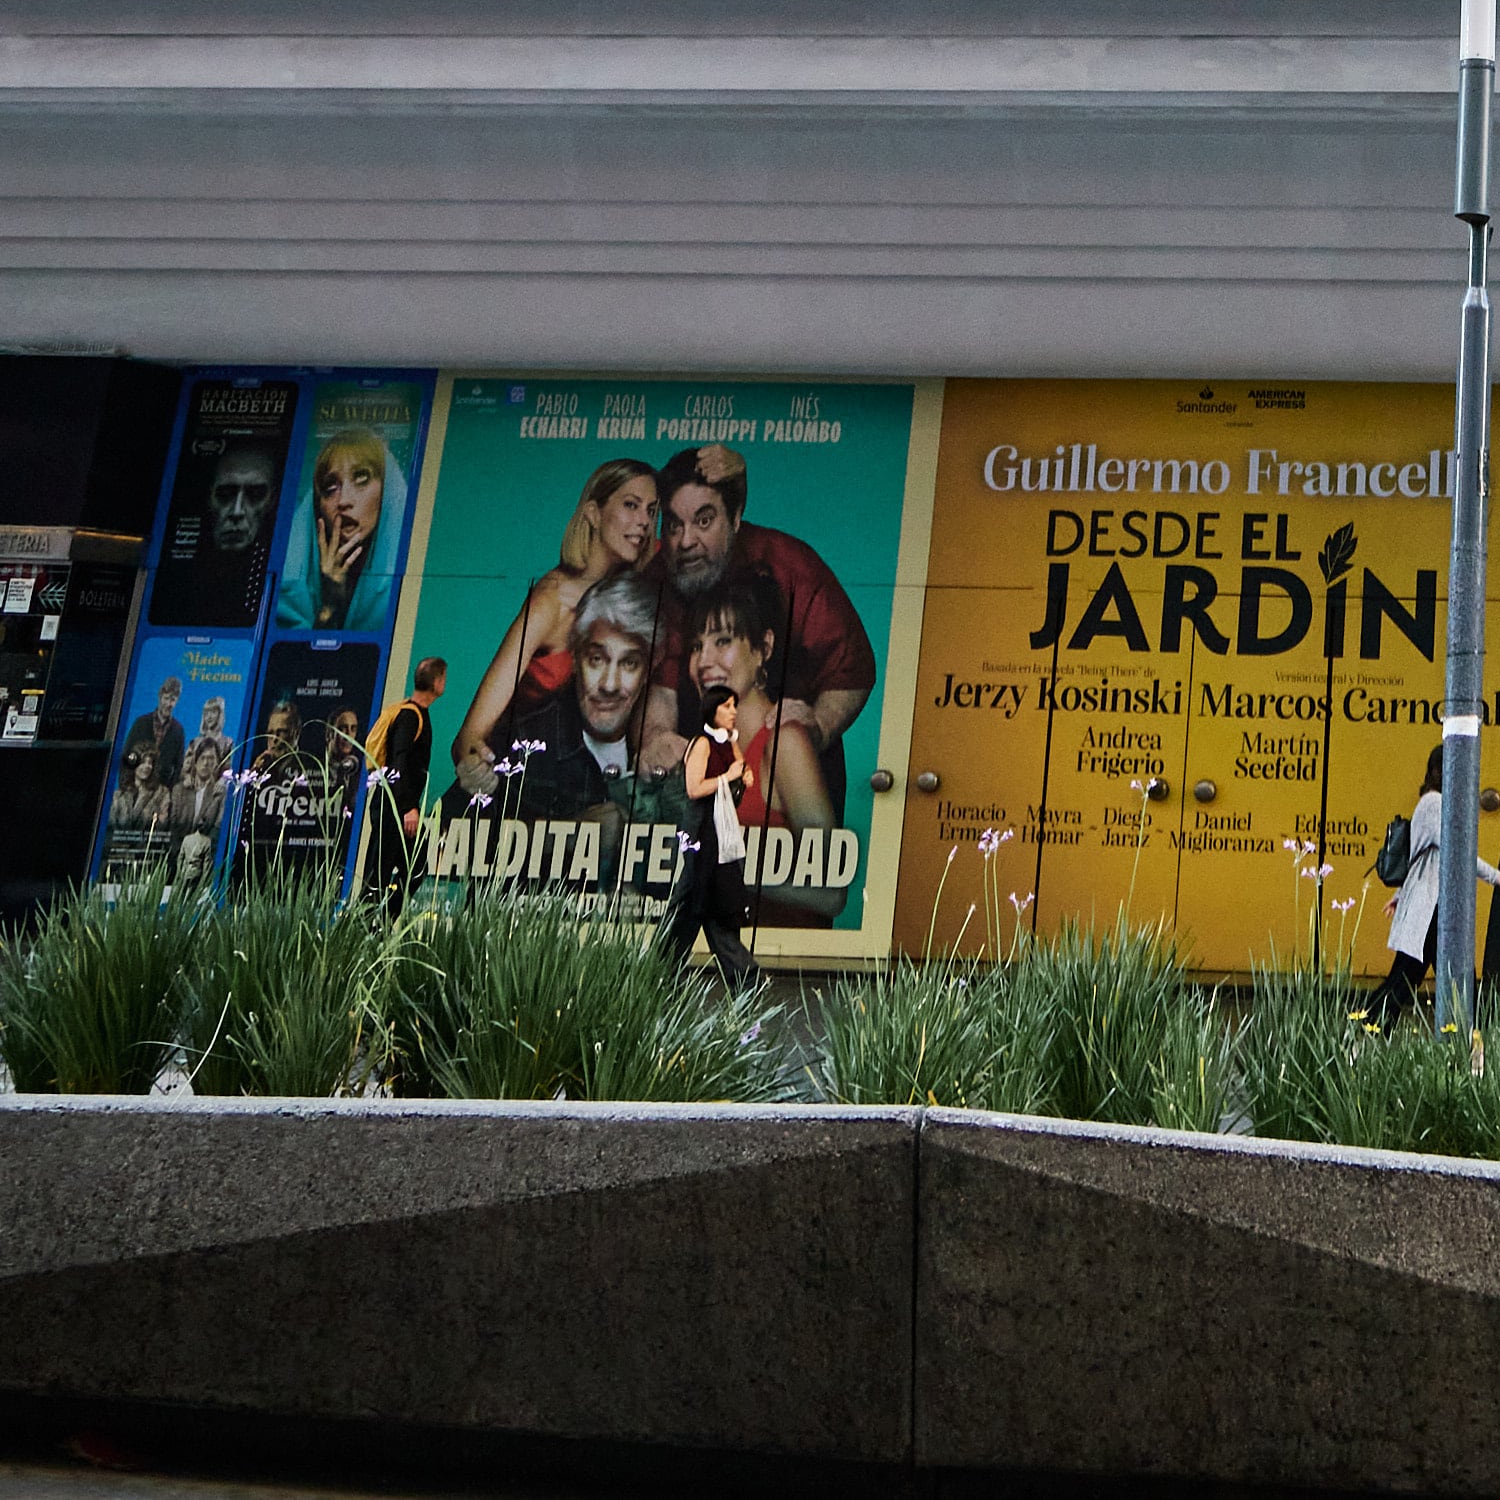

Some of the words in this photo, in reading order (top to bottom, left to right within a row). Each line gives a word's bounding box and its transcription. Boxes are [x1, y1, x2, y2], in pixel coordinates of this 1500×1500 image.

[199, 400, 286, 414] MACBETH
[535, 393, 579, 416] PABLO
[603, 393, 646, 417] PAOLA
[684, 394, 735, 419] CARLOS
[1176, 400, 1238, 414] Santander
[1247, 389, 1306, 400] AMERICAN
[1255, 400, 1306, 410] EXPRESS
[519, 415, 588, 440] ECHARRI
[597, 416, 646, 441] KRUM
[655, 417, 758, 442] PORTALUPPI
[763, 420, 842, 444] PALOMBO
[983, 442, 1231, 495] Guillermo
[1243, 448, 1457, 499] Francell
[1046, 509, 1224, 559] DESDE
[1241, 512, 1302, 561] EL
[934, 673, 1028, 720] Jerzy
[1036, 676, 1182, 716] Kosinski
[1198, 682, 1333, 720] Marcos
[1081, 725, 1162, 751] Andrea
[1240, 730, 1319, 756] Martín
[1075, 750, 1165, 778] Frigerio
[1233, 756, 1317, 782] Seefeld
[937, 801, 1007, 821] Horacio
[1103, 806, 1152, 827] Diego
[1195, 811, 1252, 832] Daniel
[1101, 828, 1150, 848] Jaraz
[1168, 830, 1275, 854] Miglioranza
[618, 822, 859, 888] FEIDAD
